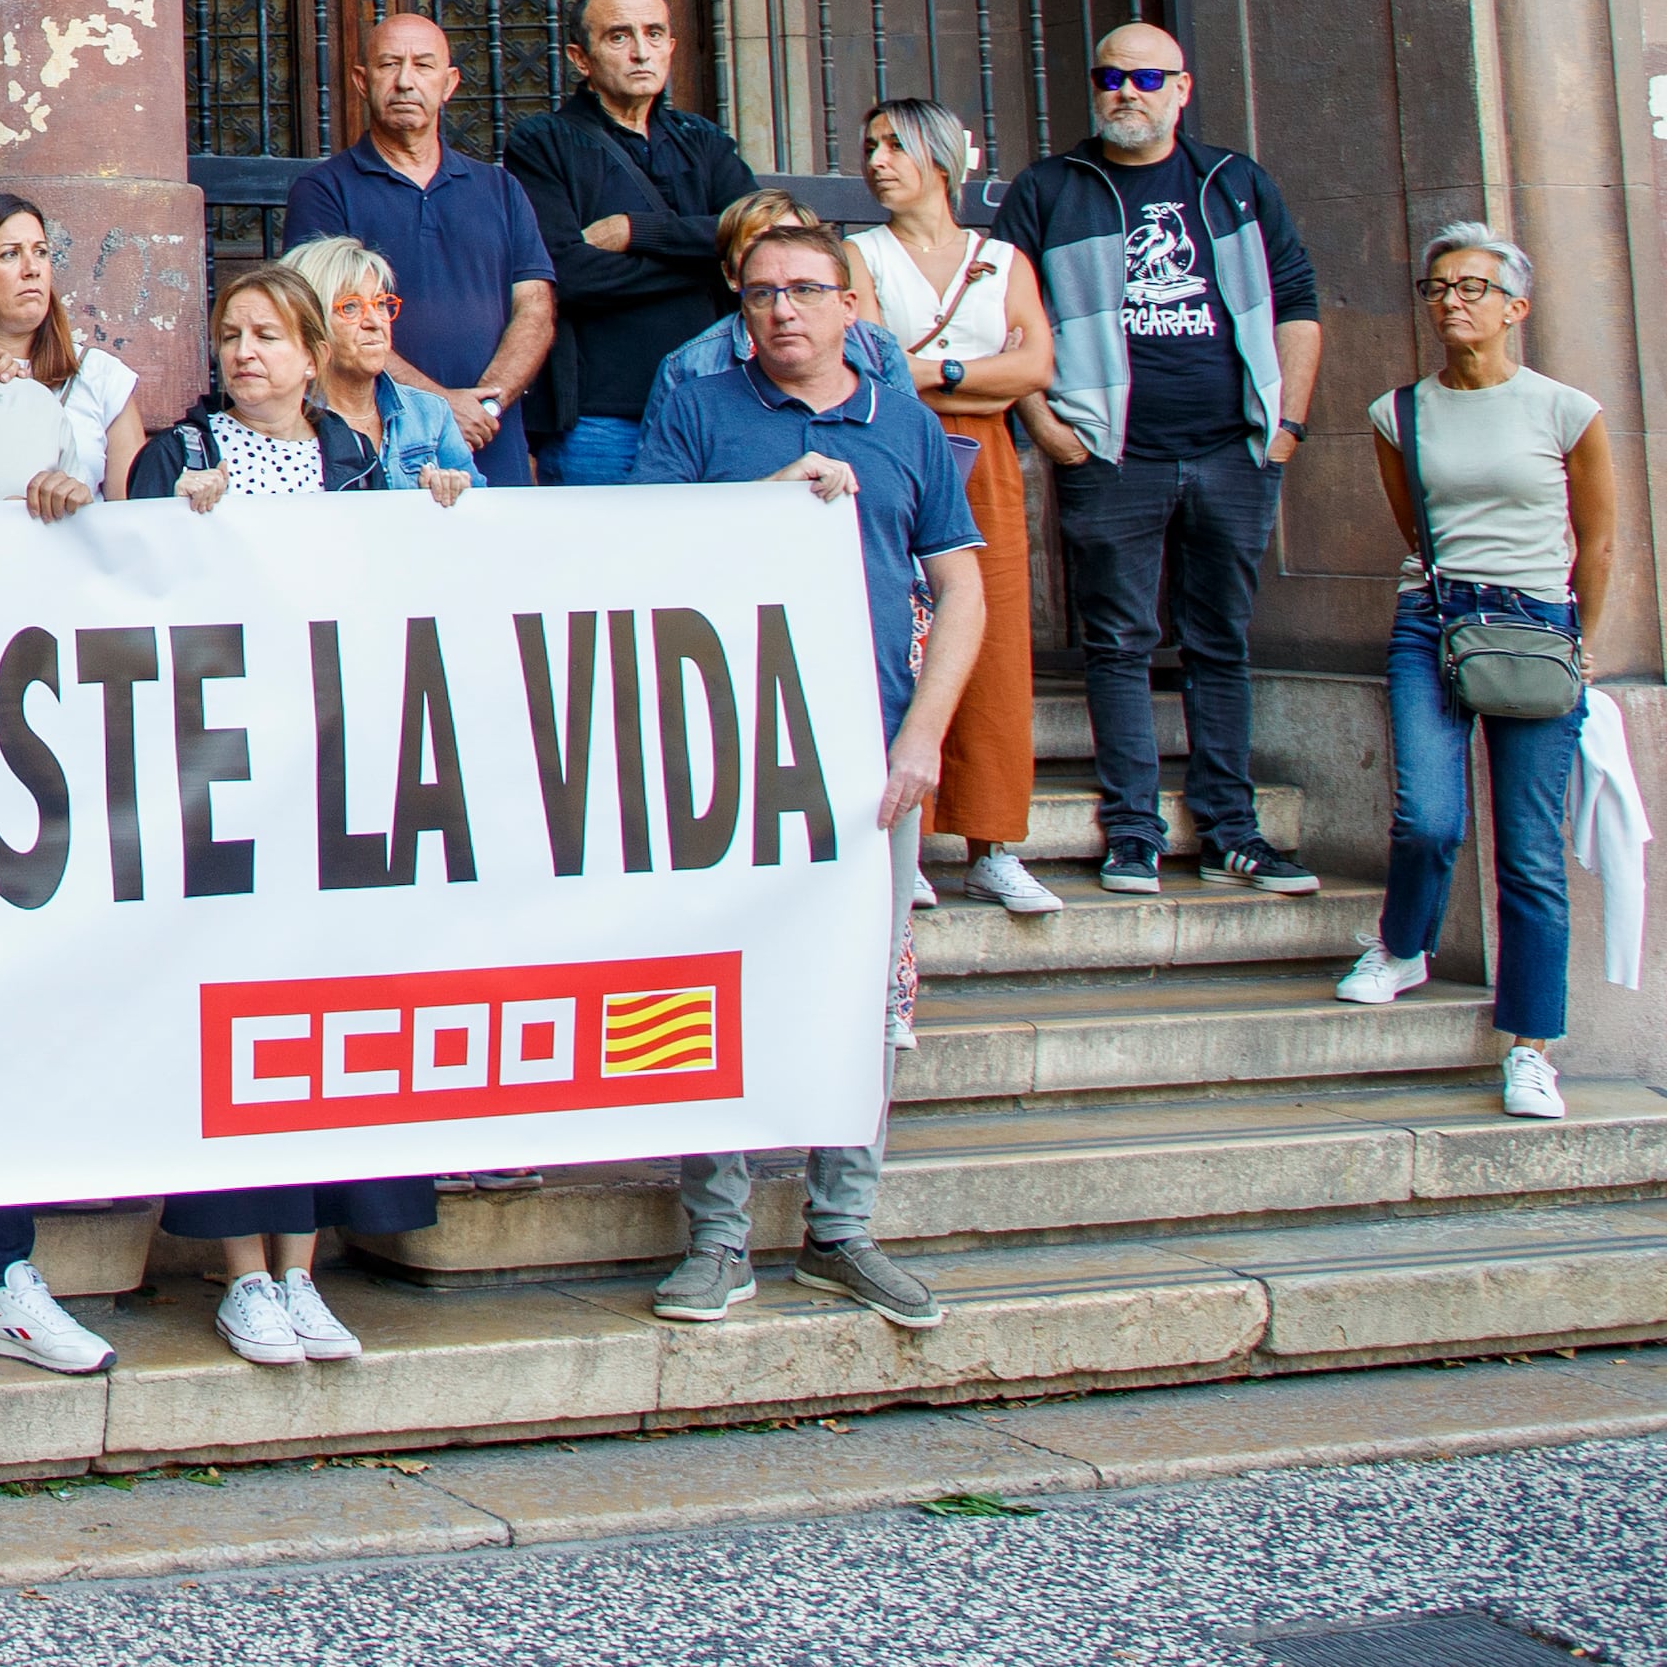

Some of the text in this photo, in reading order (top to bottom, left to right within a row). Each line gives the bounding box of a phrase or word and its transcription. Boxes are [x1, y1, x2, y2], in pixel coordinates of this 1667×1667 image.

[309, 616, 478, 891] LA
[513, 603, 838, 878] VIDA
[232, 996, 576, 1105] CCOO
